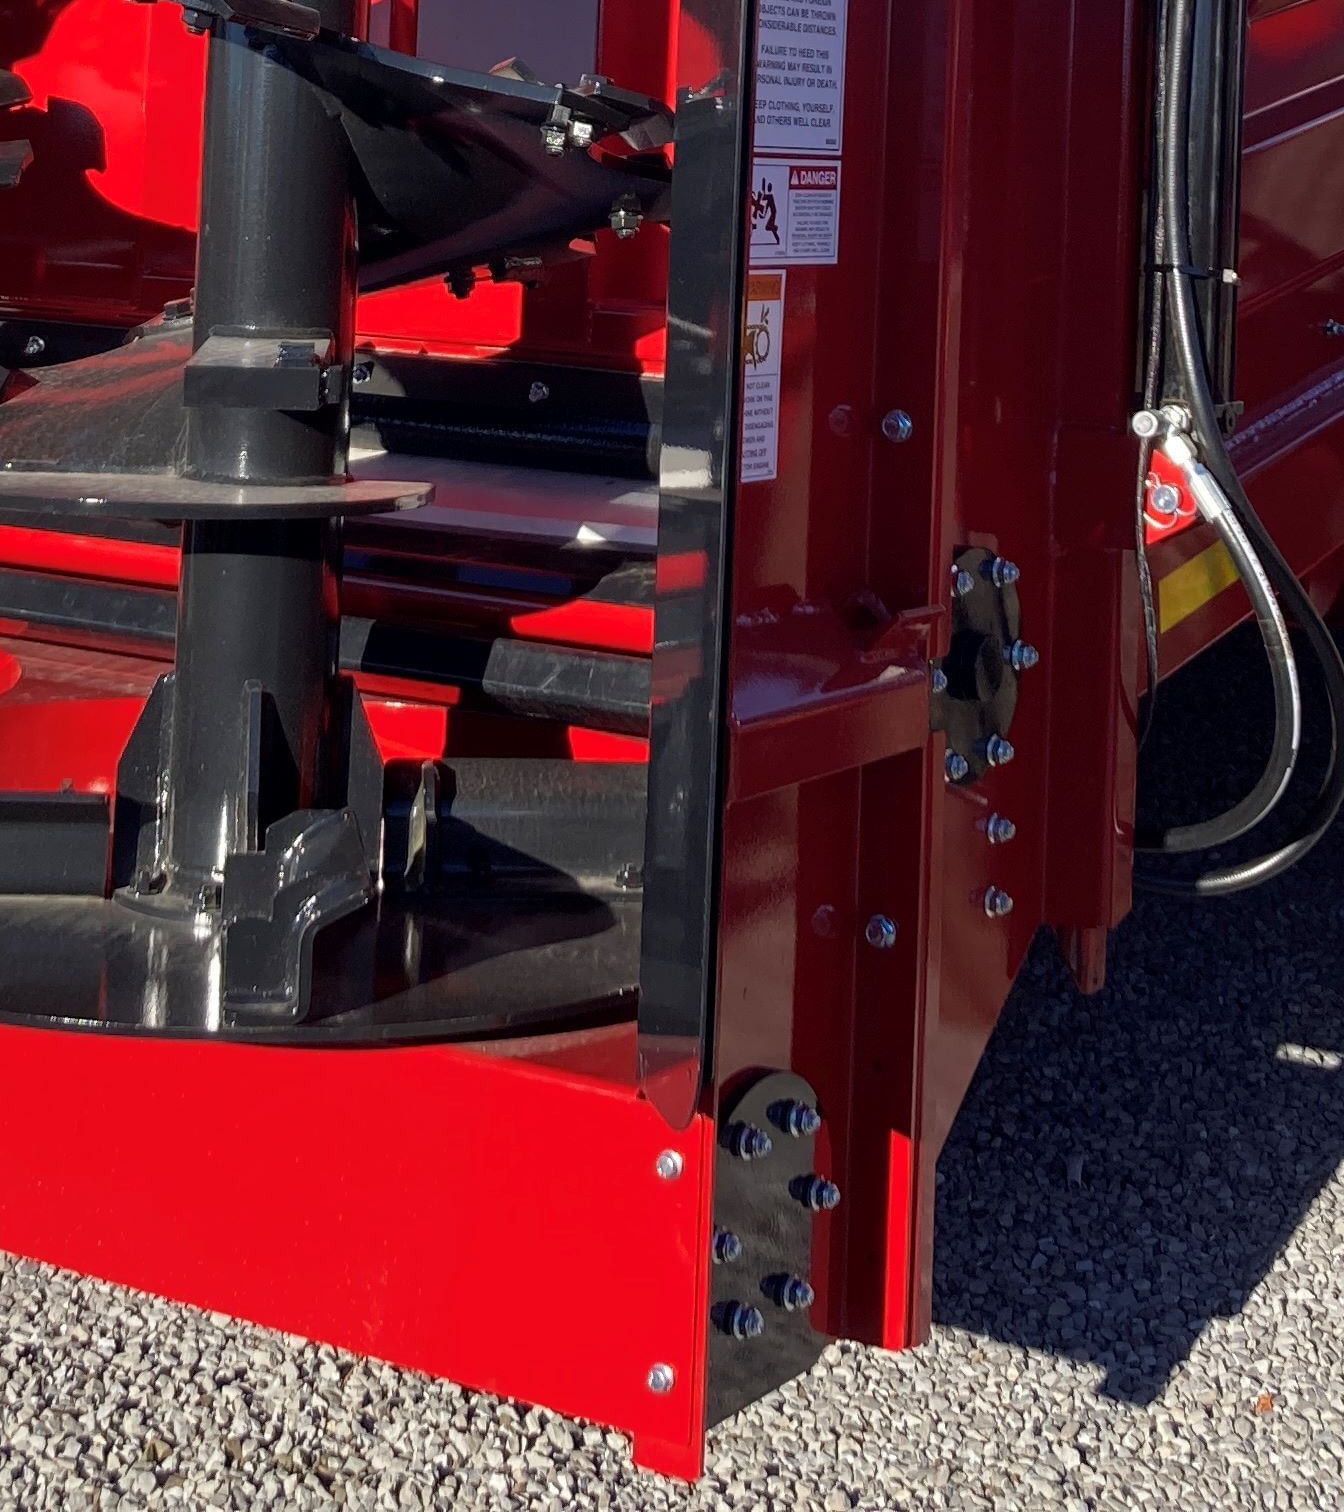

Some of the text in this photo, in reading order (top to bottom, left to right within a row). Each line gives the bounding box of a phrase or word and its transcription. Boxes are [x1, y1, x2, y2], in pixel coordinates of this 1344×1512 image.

[787, 7, 799, 17] CAN
[801, 8, 809, 18] BE
[759, 19, 802, 33] ONSIDERABLE
[787, 62, 801, 72] MAY
[802, 63, 825, 74] RESULT
[757, 74, 782, 86] RSONAL
[806, 78, 816, 88] OR
[755, 100, 766, 110] EEP
[756, 115, 765, 124] ND
[793, 117, 810, 127] WELL
[800, 170, 837, 185] DANGER
